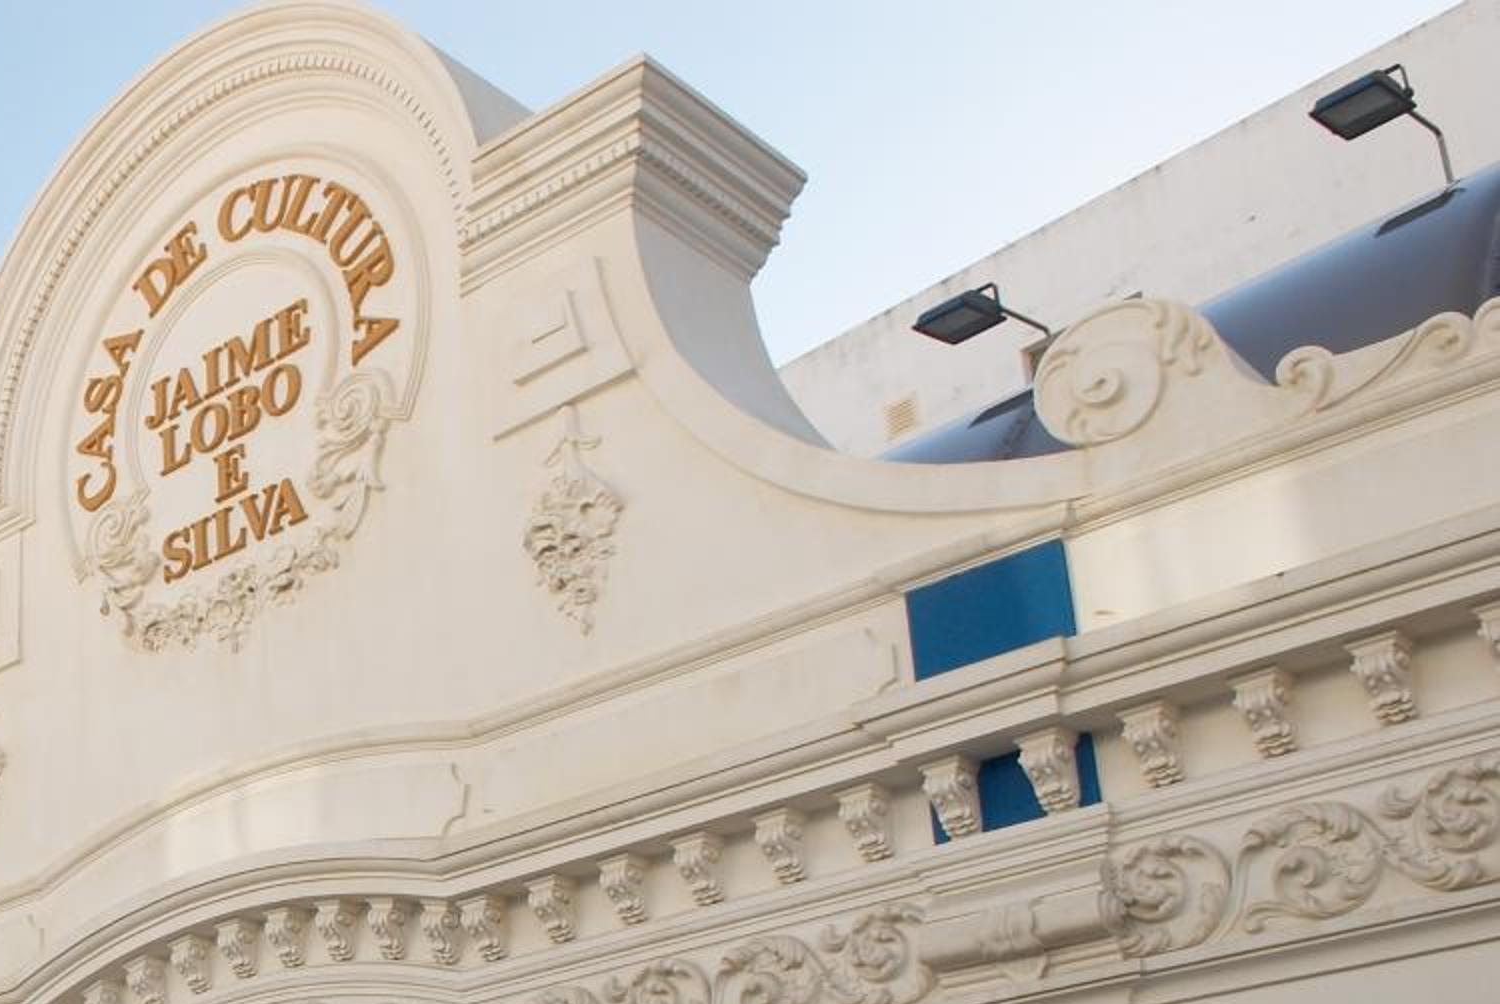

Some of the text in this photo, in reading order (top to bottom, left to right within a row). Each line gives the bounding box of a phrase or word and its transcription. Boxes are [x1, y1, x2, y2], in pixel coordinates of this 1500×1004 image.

[76, 173, 401, 513] CASA DE CULTURA
[145, 298, 311, 430] JAIME
[159, 363, 302, 477] LOBO
[213, 444, 249, 504] E
[163, 477, 309, 584] SILVA
